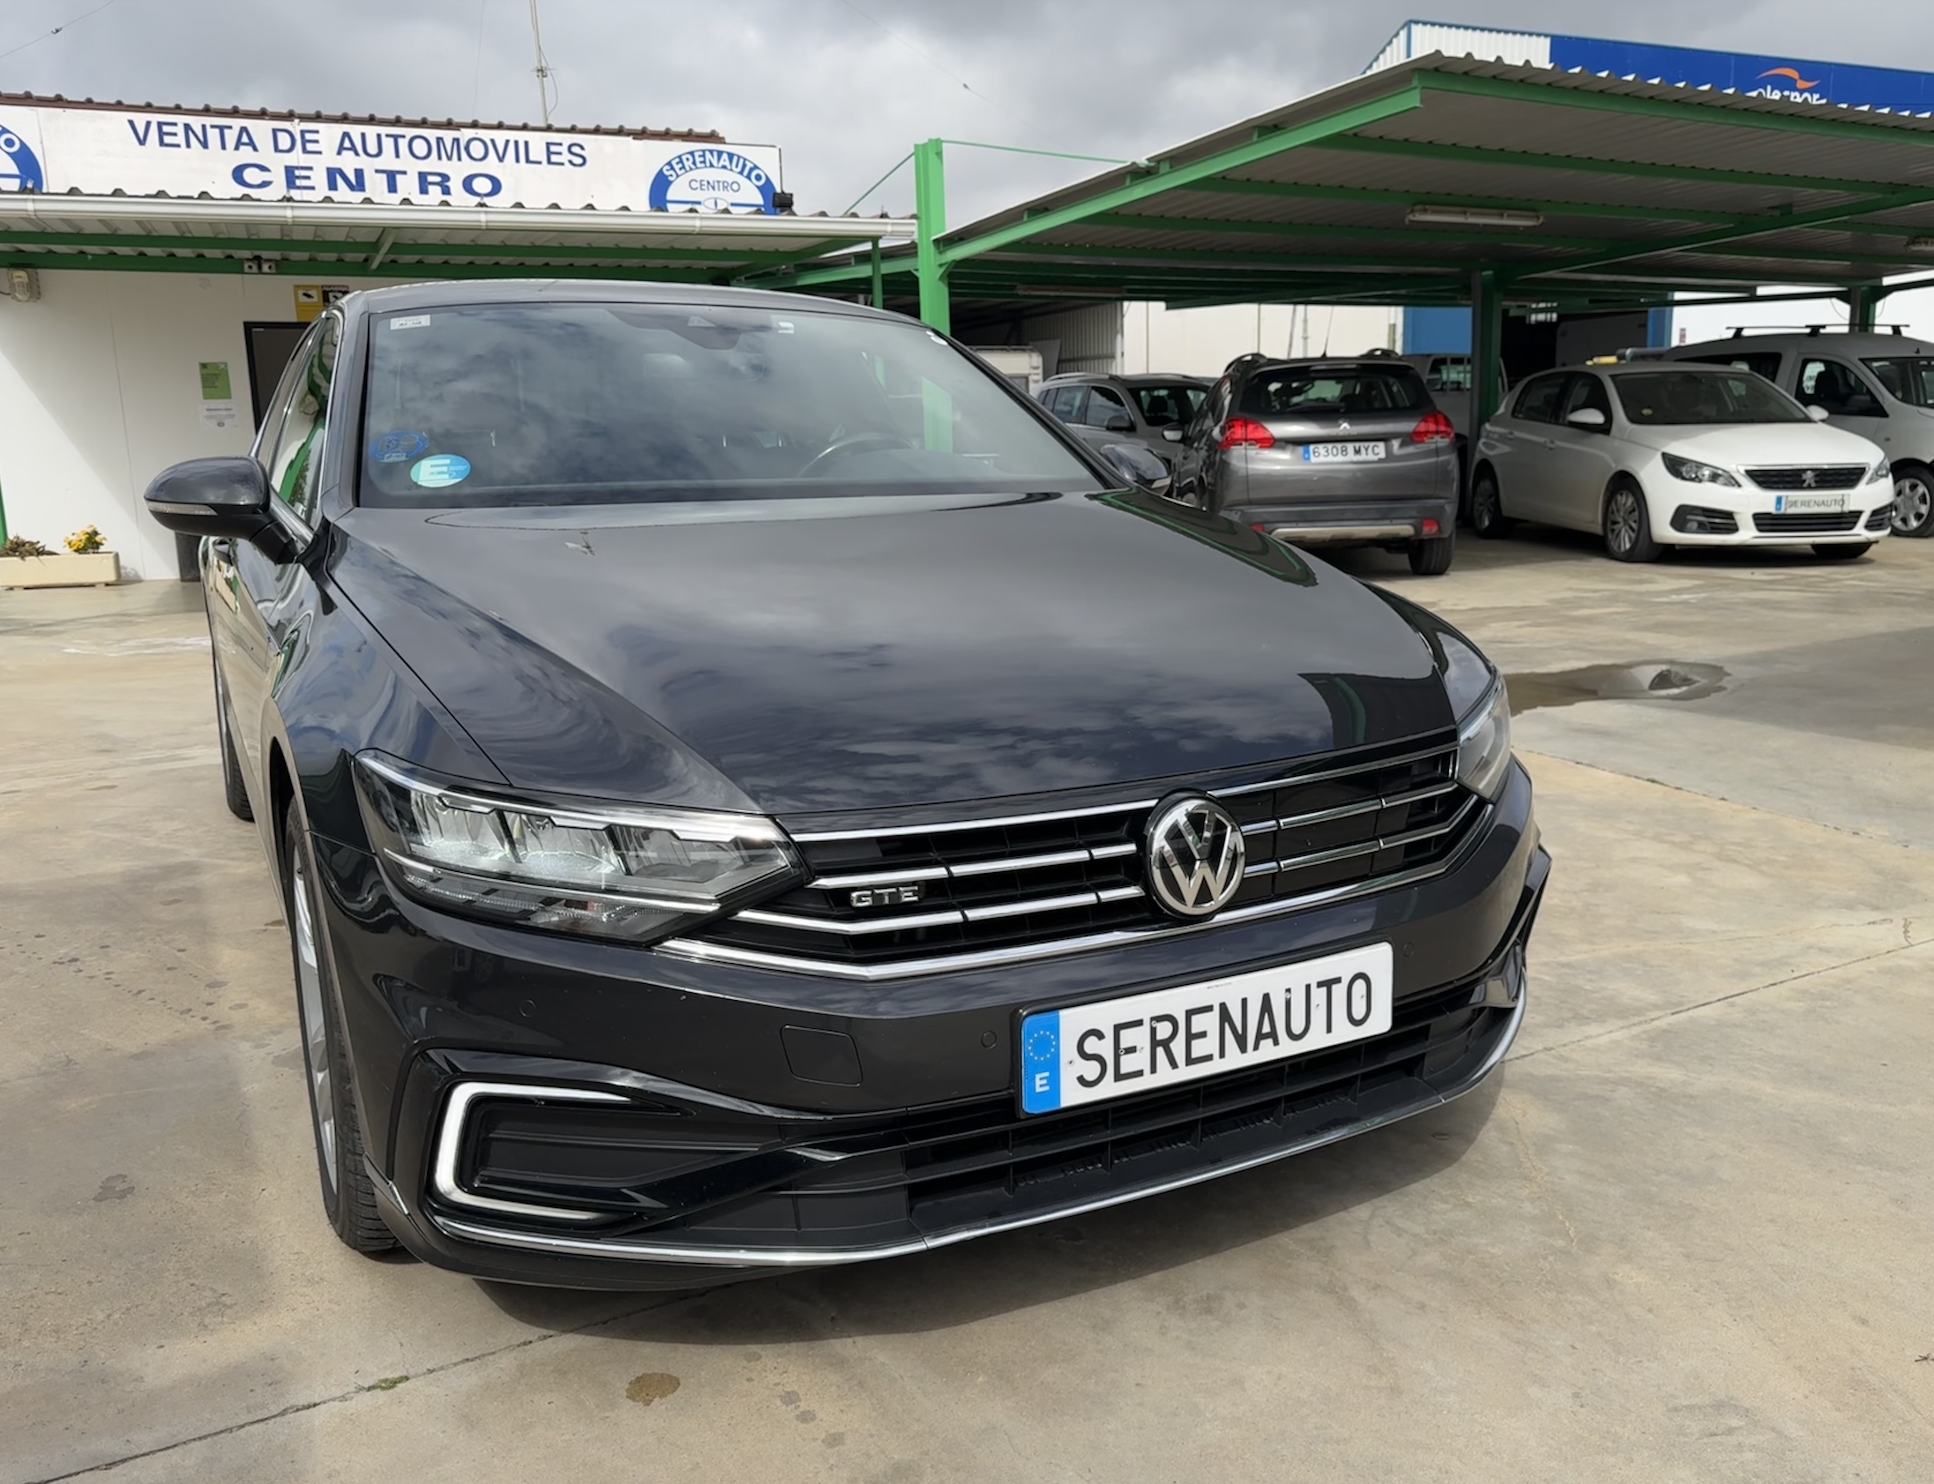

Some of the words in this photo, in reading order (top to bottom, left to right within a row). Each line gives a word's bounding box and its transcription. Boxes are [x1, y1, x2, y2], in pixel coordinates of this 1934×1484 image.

[127, 118, 260, 153] VENTA
[271, 127, 323, 155] DE
[336, 130, 588, 168] AUTOMOVILES
[231, 162, 503, 198] CENTRO
[662, 150, 767, 187] SERENAUTO
[688, 178, 741, 193] CENTRO
[1312, 445, 1349, 458] 6308
[1353, 444, 1380, 457] MYC
[850, 886, 919, 908] GTE
[1076, 971, 1373, 1088] SERENAUTO
[1035, 1071, 1050, 1093] E
